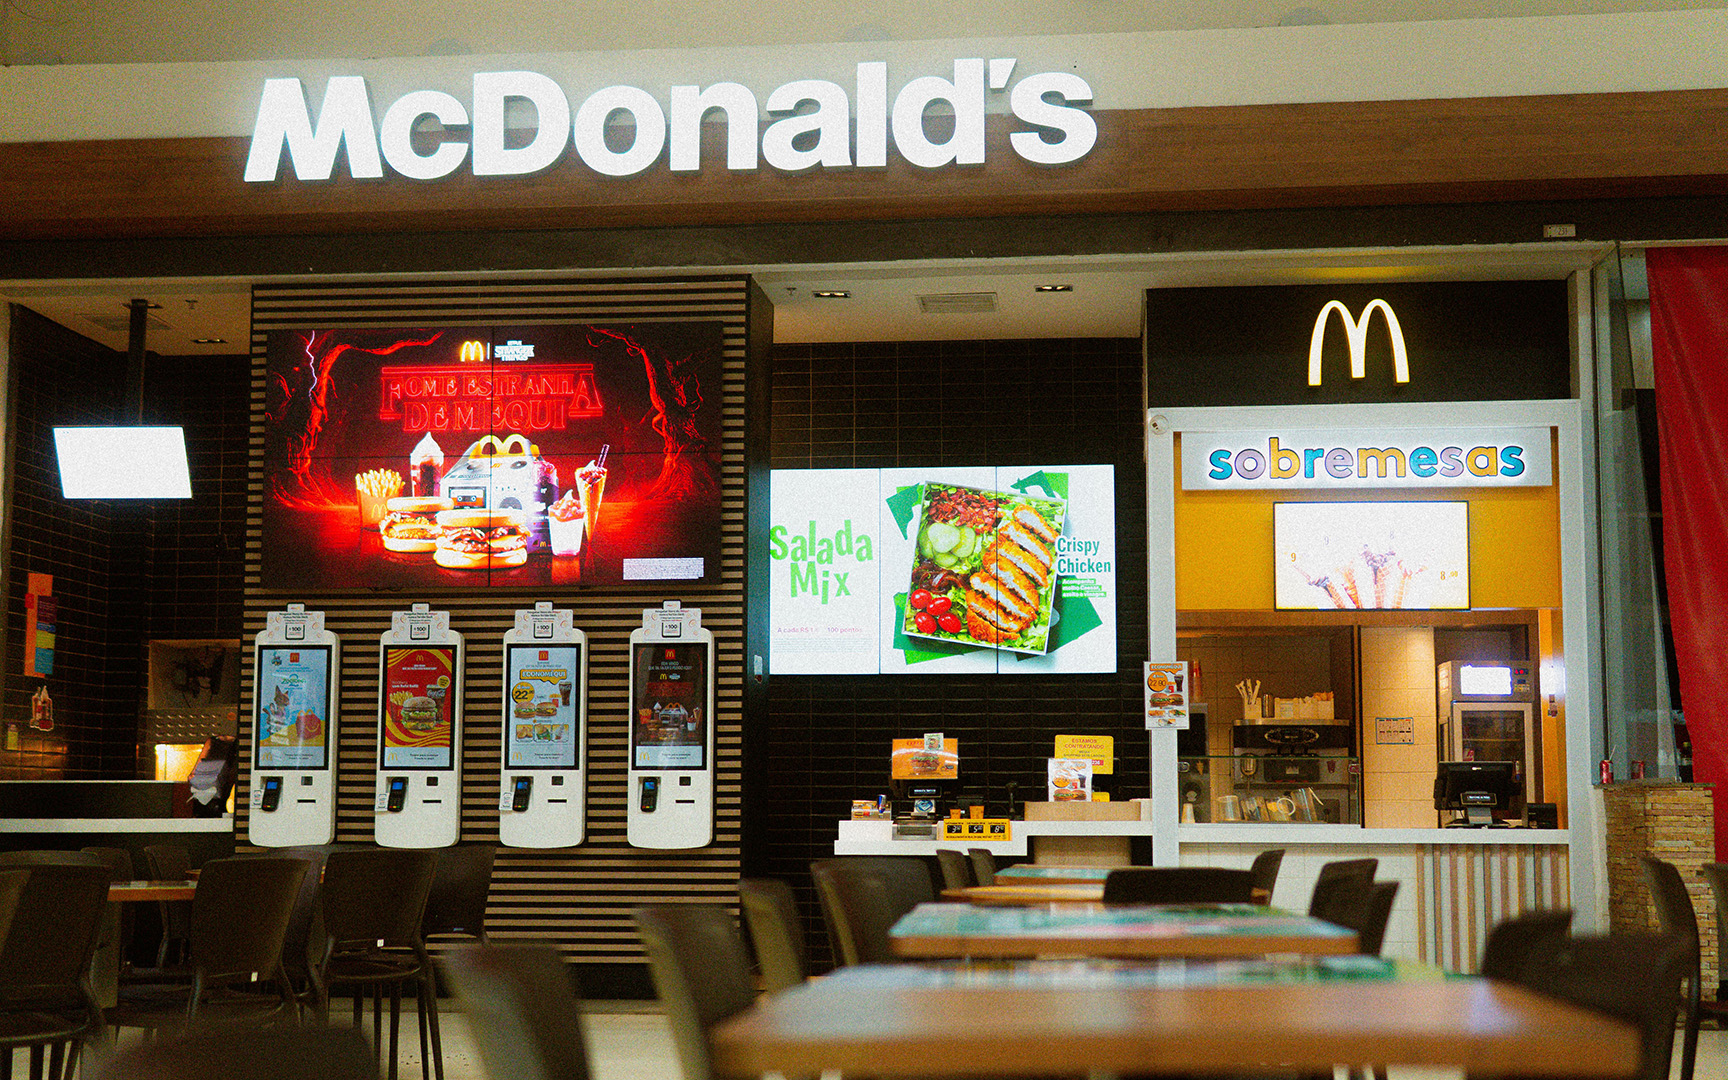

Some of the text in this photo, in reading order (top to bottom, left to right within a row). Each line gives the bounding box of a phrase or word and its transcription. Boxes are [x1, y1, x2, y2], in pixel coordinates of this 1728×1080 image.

[243, 58, 1098, 183] McDonald's
[380, 373, 603, 413] FOME ESTRANHA
[404, 401, 450, 431] DE
[1208, 437, 1525, 480] sobremesas
[769, 519, 873, 565] Salada
[1058, 537, 1100, 556] Crispy
[790, 562, 851, 605] Mix
[1058, 558, 1111, 573] Chicken
